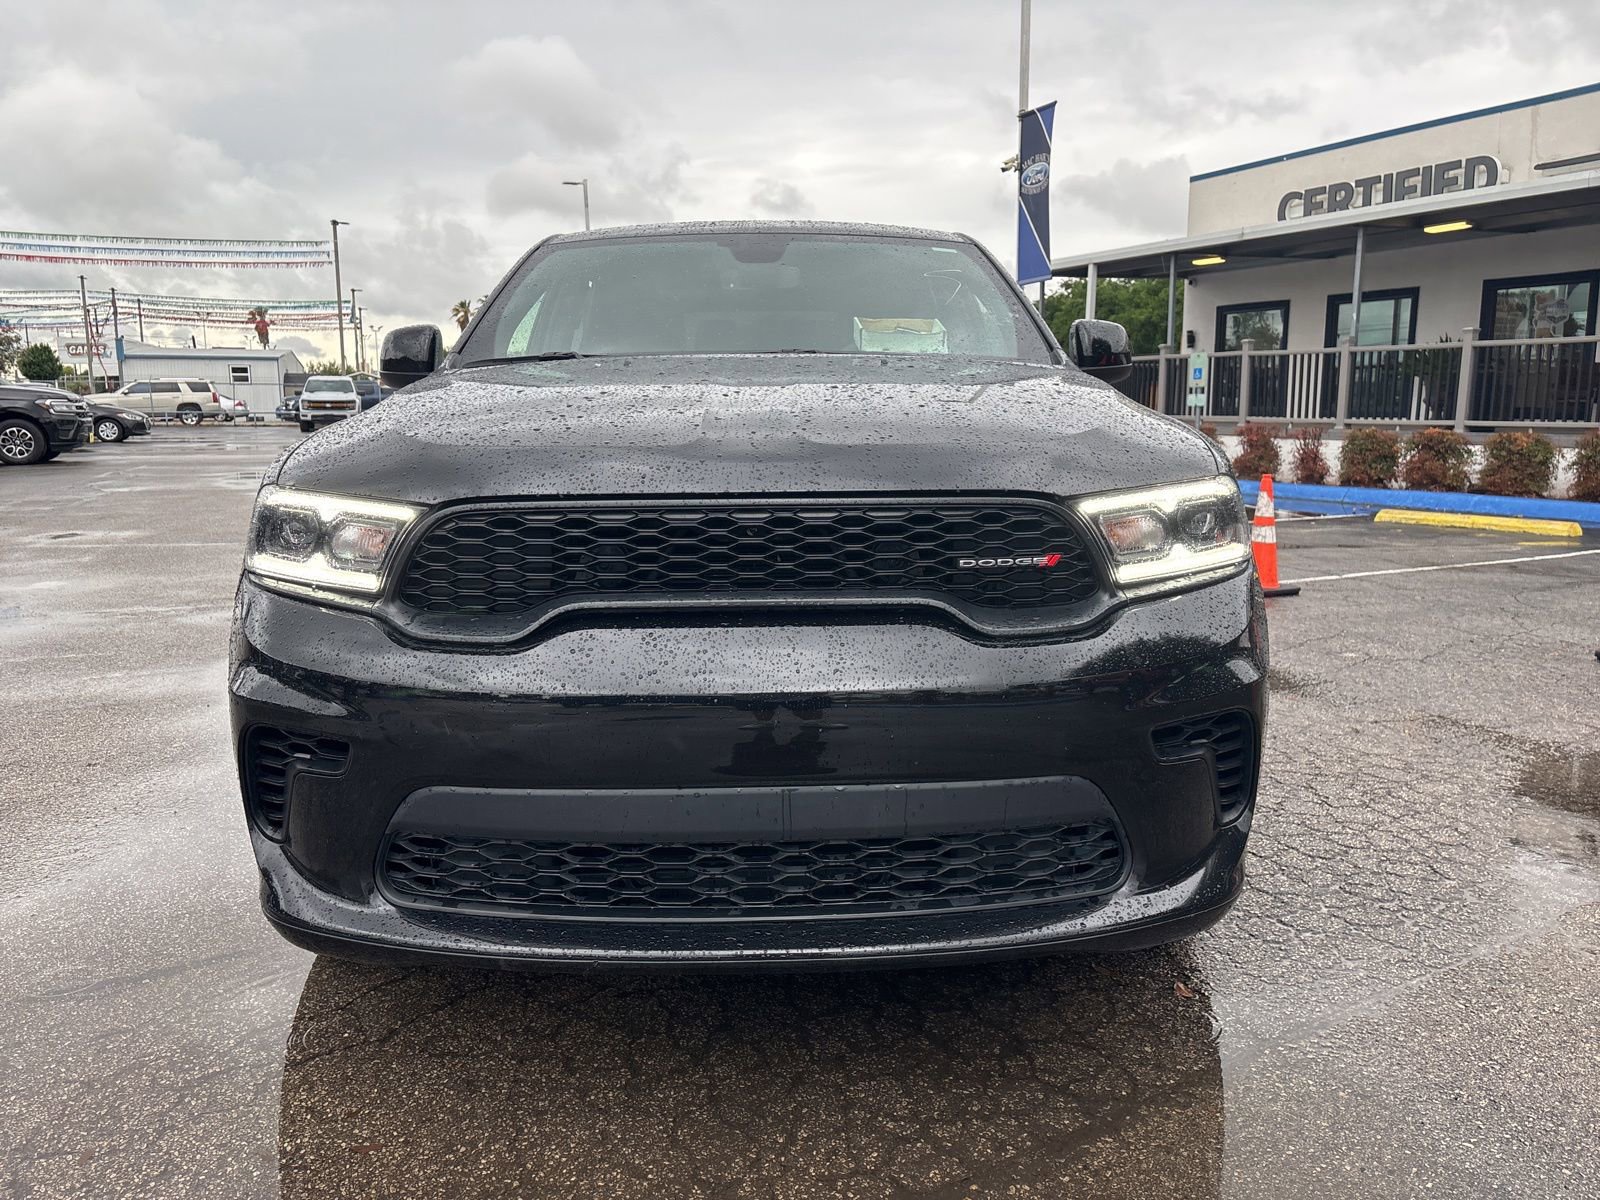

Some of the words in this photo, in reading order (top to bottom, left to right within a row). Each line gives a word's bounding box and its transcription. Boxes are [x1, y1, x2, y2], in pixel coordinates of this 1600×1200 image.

[1025, 165, 1045, 184] Ford
[1278, 155, 1500, 221] CERTIFIED
[959, 557, 1048, 567] DODGE
